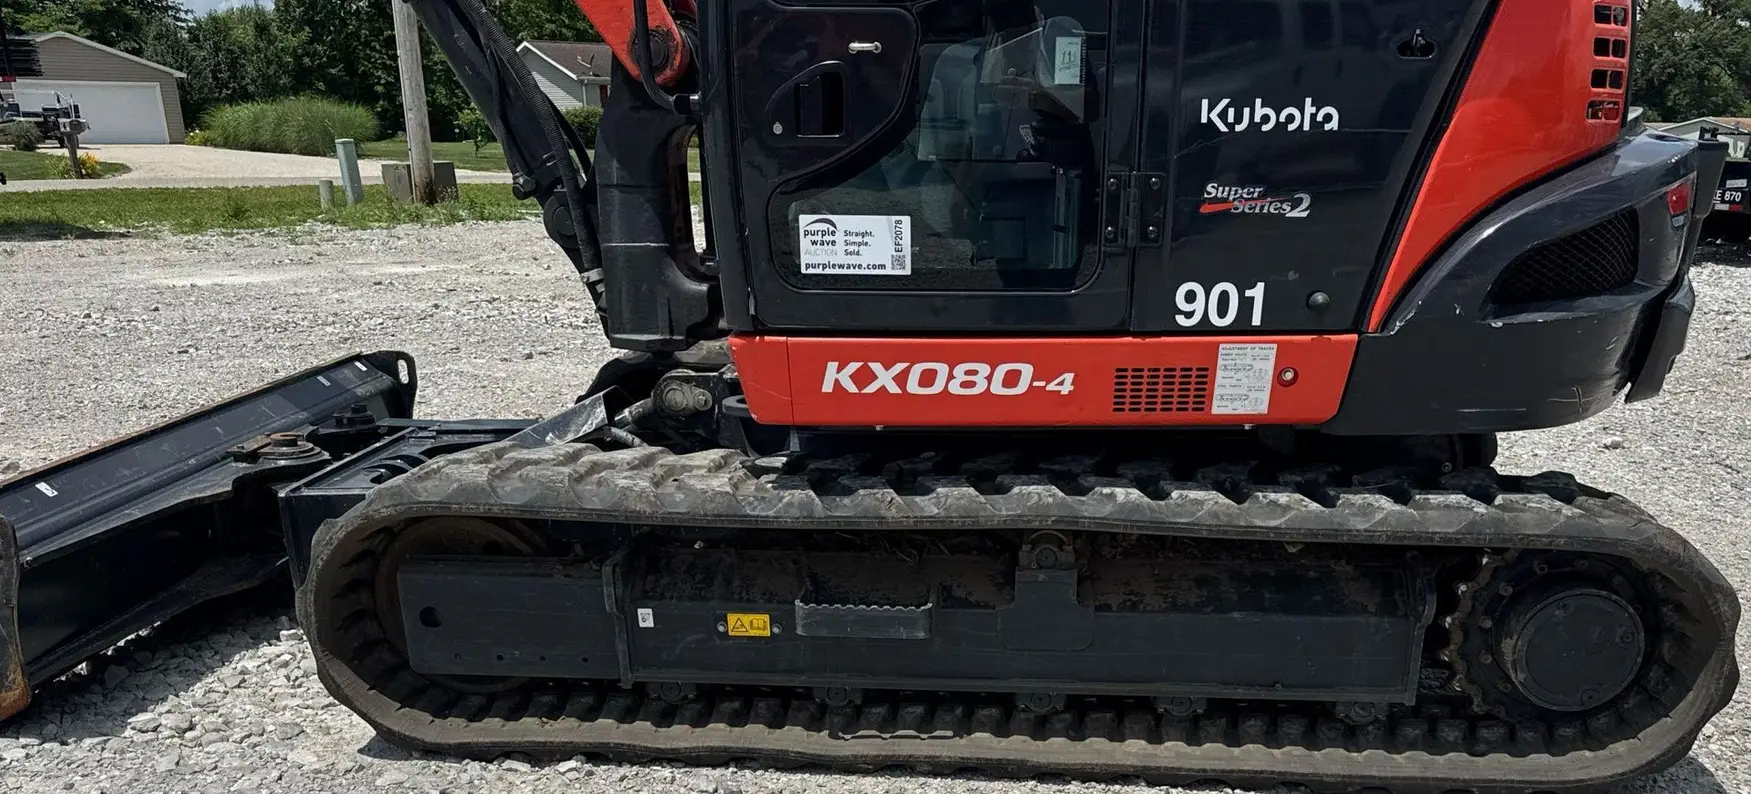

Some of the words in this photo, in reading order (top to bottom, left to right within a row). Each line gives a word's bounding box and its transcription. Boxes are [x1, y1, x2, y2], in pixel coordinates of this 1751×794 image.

[1200, 97, 1340, 132] Kubota
[1203, 183, 1263, 200] Super
[1724, 191, 1741, 202] 870
[803, 228, 836, 238] purple
[843, 230, 874, 238] Straight.
[894, 219, 903, 253] EF2078
[810, 238, 837, 247] wave
[804, 248, 837, 256] AUCTION
[805, 261, 886, 271] purplewave.com
[1174, 282, 1265, 327] 901
[821, 361, 1075, 395] KX080-4
